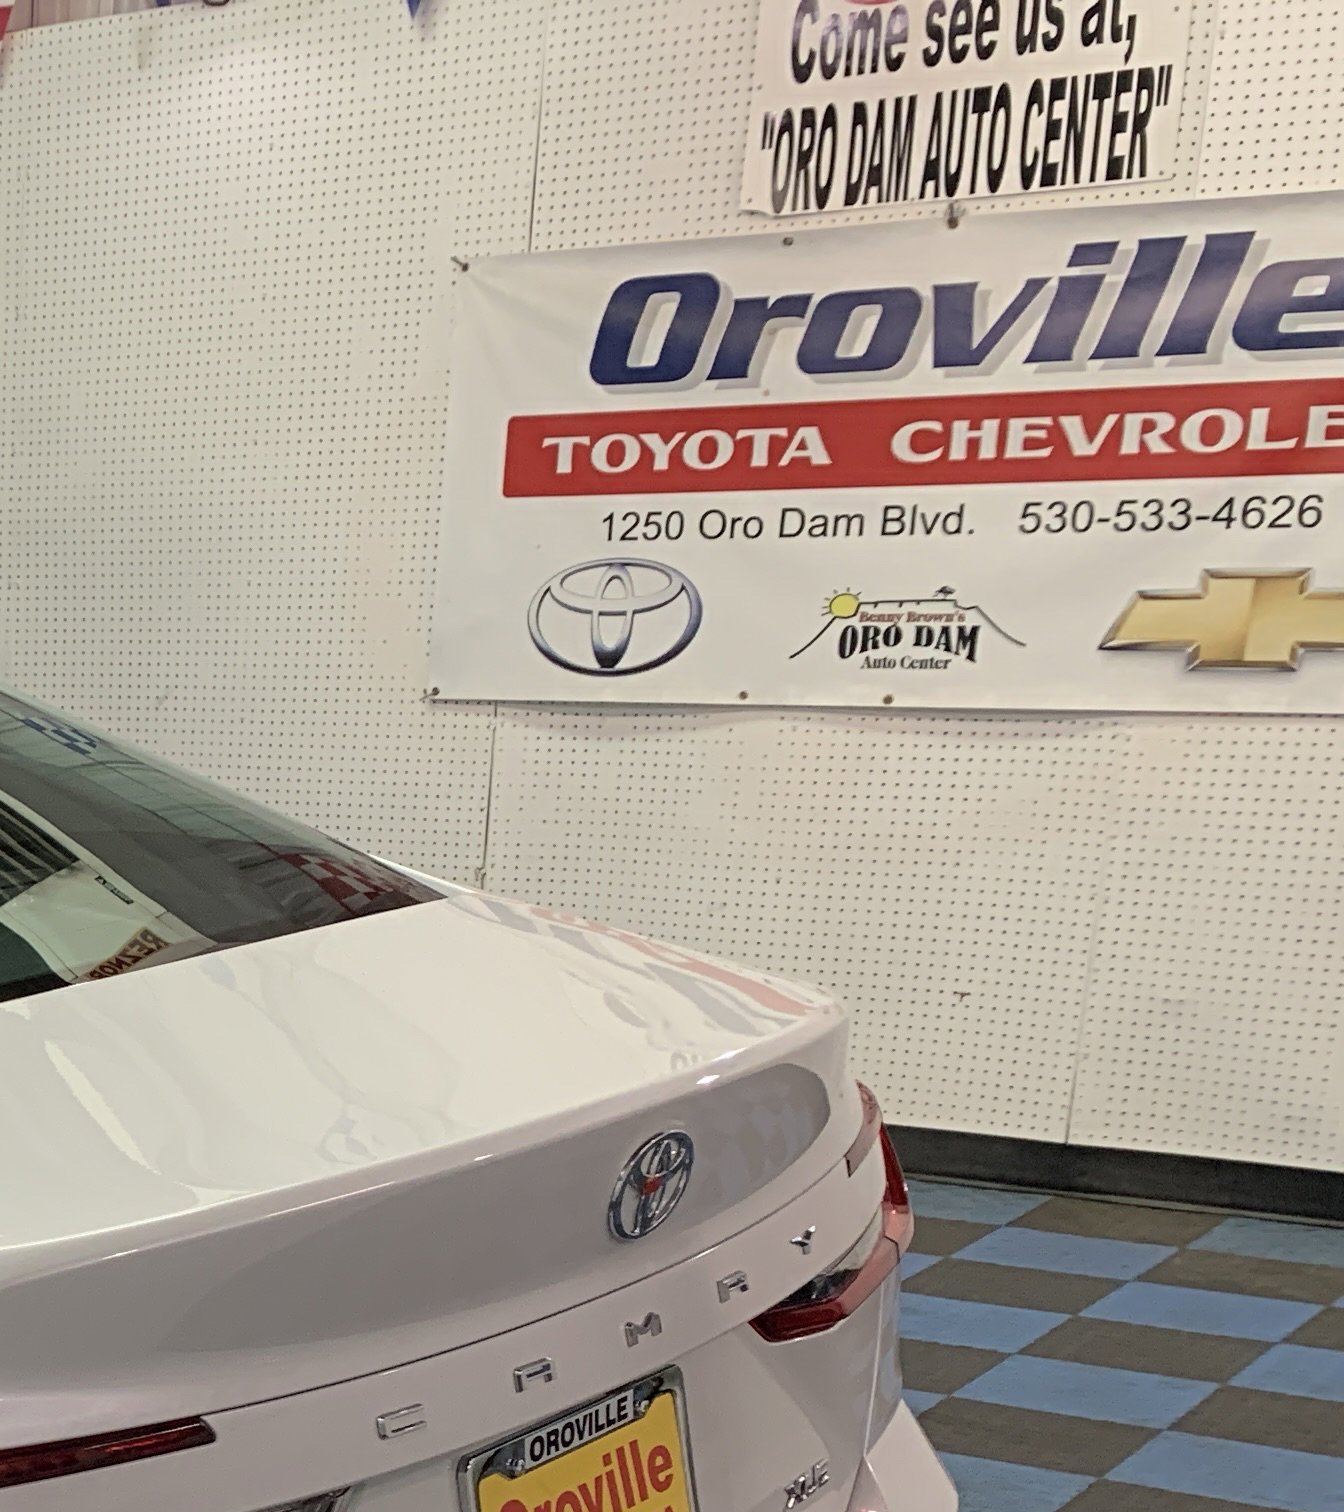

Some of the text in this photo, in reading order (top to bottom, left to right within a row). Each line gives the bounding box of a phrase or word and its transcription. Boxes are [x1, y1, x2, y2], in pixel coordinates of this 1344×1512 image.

[790, 0, 909, 84] Come
[921, 0, 1000, 68] see
[1015, 0, 1065, 56] us
[761, 64, 1174, 214] "ORO DAM AUTO CENTER"
[588, 230, 1344, 387] Oroville
[542, 425, 833, 476] TOYOTA
[600, 492, 1325, 542] 1250 Oro Dam Blvd. 530-533-4626
[838, 624, 982, 664] ORO DAM
[859, 610, 967, 627] Benny Brown's
[860, 655, 953, 670] Auto Center
[375, 1225, 817, 1440] CAMRY
[528, 1395, 630, 1463] OROVILLE
